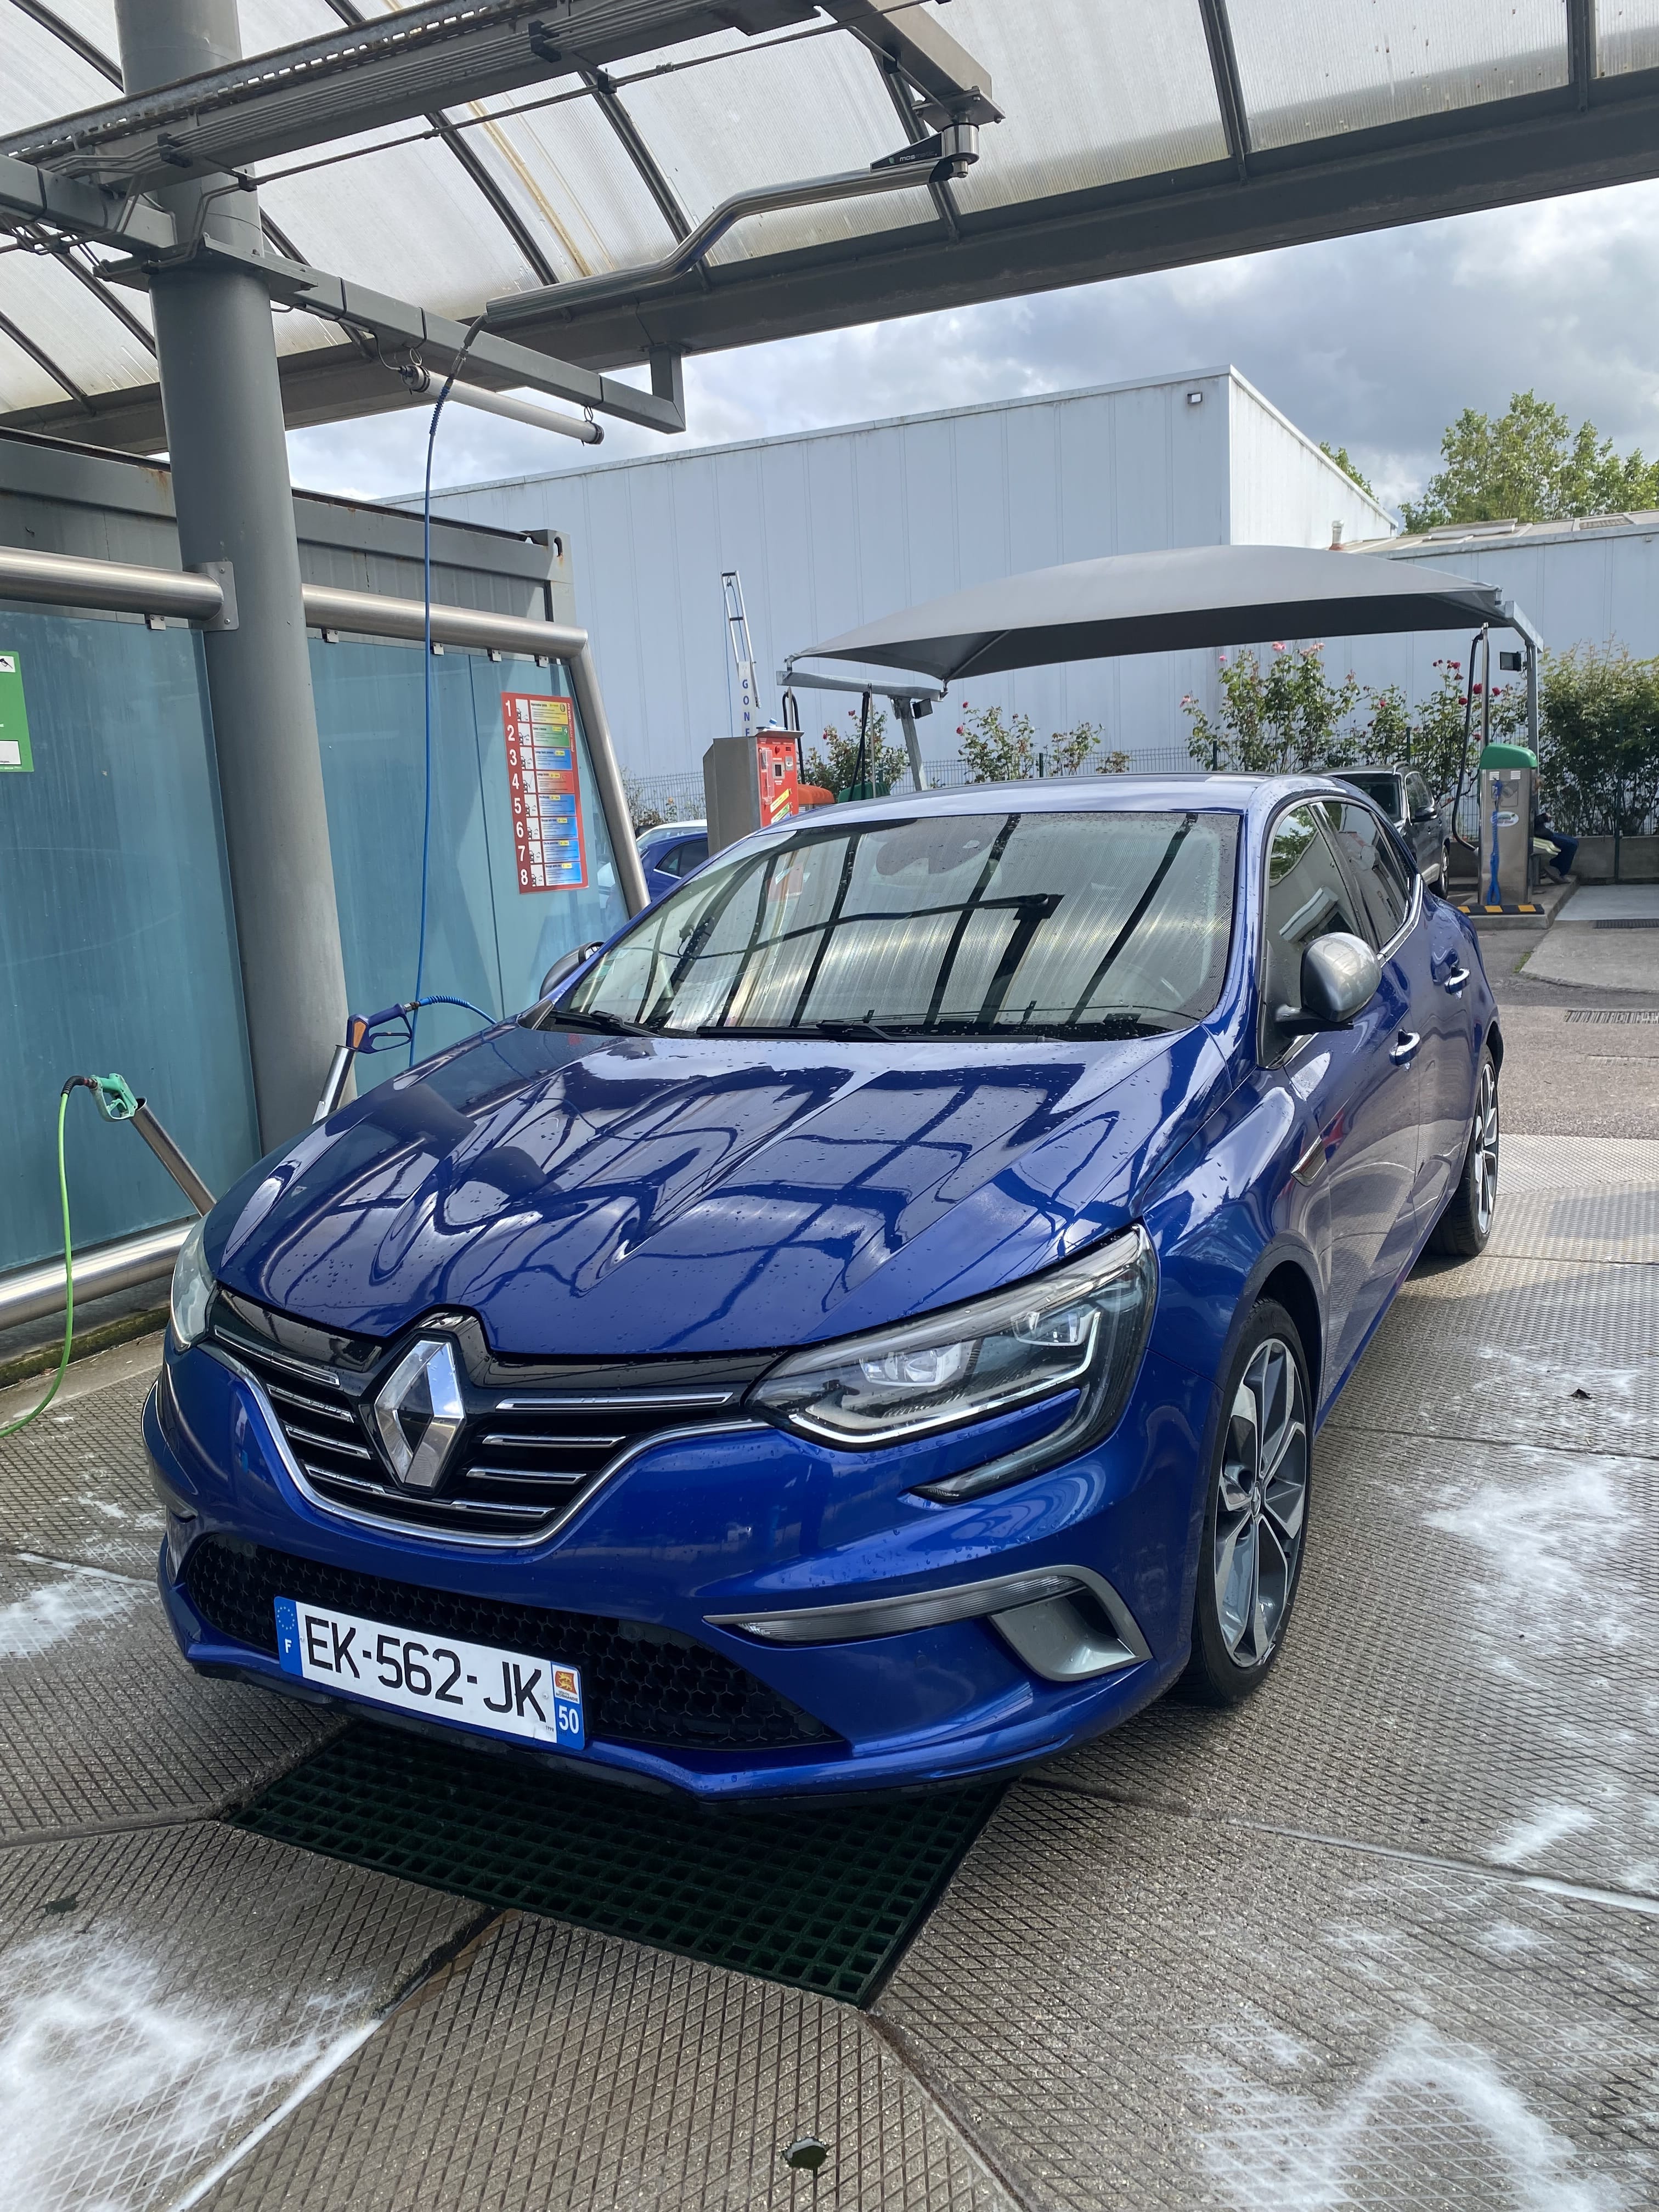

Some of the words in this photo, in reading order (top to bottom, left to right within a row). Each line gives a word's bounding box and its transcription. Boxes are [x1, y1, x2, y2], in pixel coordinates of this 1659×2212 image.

[505, 700, 511, 716] 1
[507, 724, 515, 741] 2
[510, 749, 517, 765] 3
[512, 773, 520, 789] 4
[514, 798, 521, 814] 5
[516, 821, 523, 838] 6
[518, 845, 525, 861] 7
[521, 869, 528, 885] 8
[285, 1638, 292, 1654] F
[305, 1615, 546, 1723] EK-562-JK
[558, 1705, 579, 1734] 50
